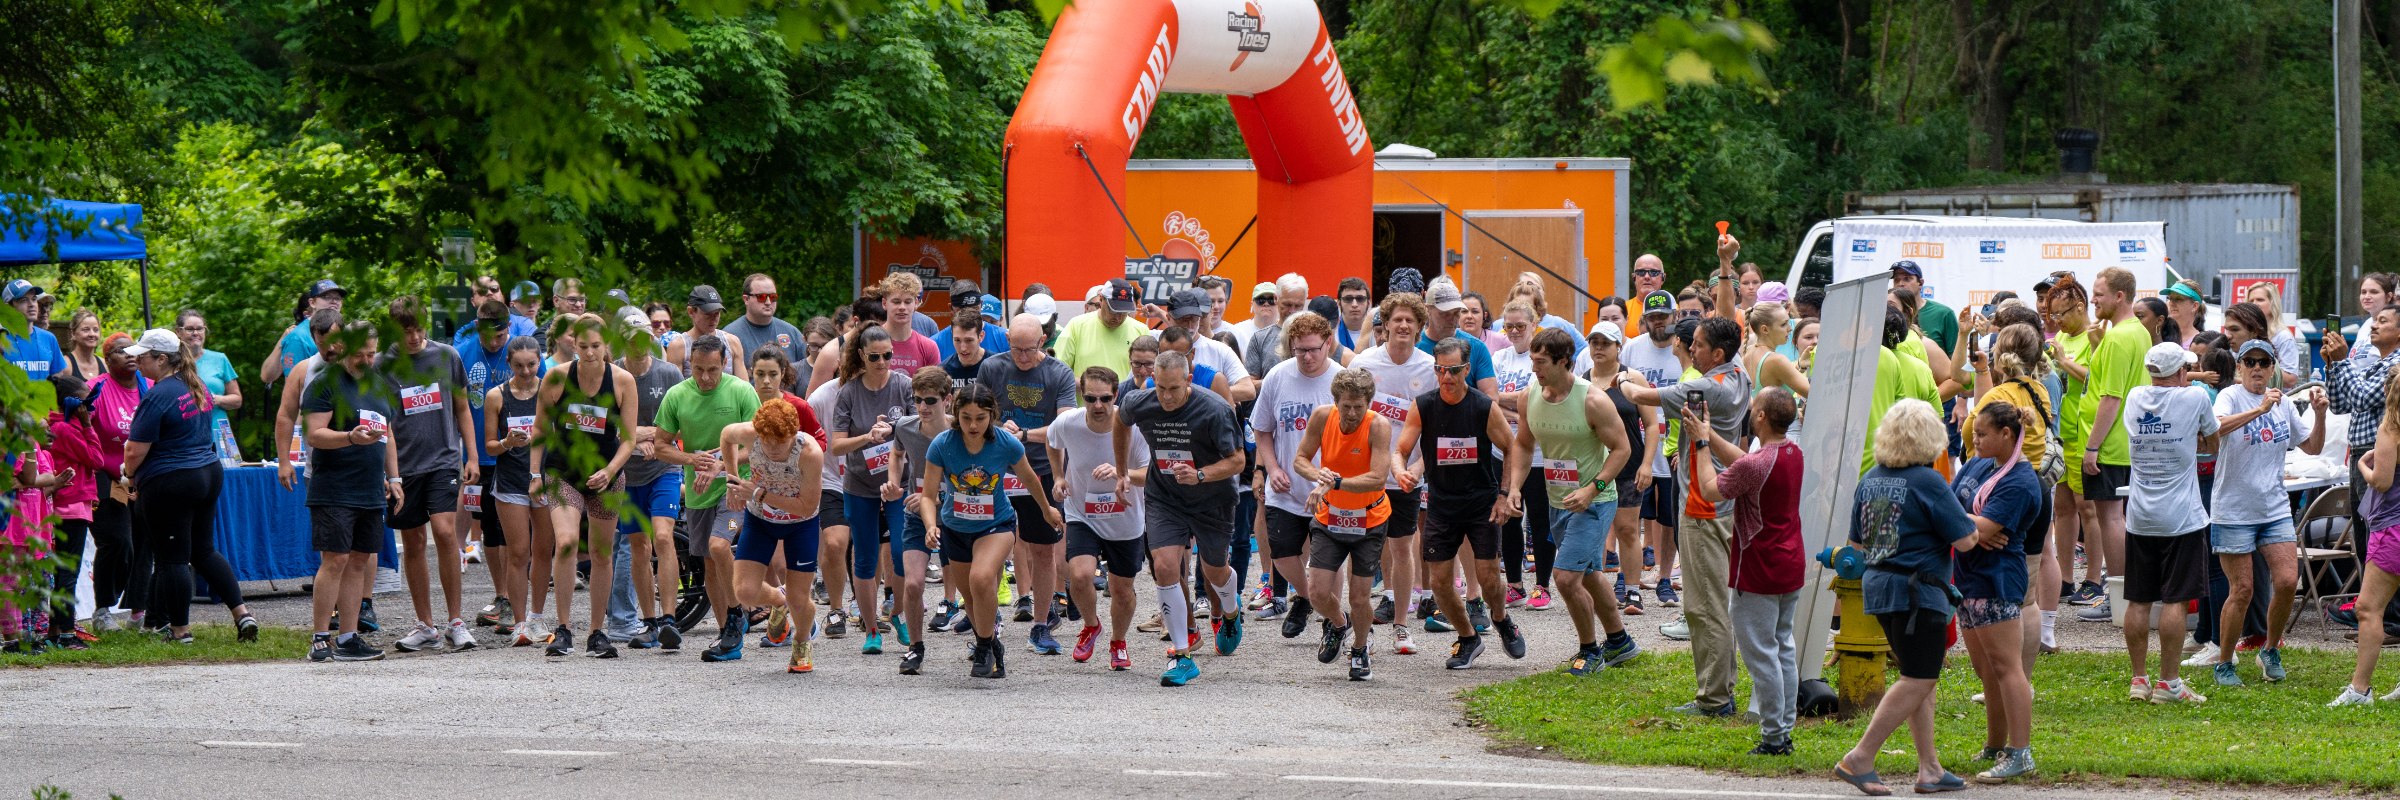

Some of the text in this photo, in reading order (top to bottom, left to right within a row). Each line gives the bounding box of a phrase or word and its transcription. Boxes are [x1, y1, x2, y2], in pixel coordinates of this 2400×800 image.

[1229, 13, 1258, 31] Racing
[1240, 29, 1269, 48] Toes
[1122, 22, 1172, 154] START
[1313, 34, 1368, 156] FINISH
[2043, 245, 2089, 258] LIVE UNITED
[1125, 258, 1194, 279] acing
[922, 278, 953, 288] oes
[1142, 276, 1193, 300] To
[28, 360, 49, 371] UNITED
[411, 394, 433, 407] 300
[1280, 403, 1313, 422] RUN
[1379, 404, 1402, 419] 245
[368, 421, 382, 431] 301
[575, 414, 597, 428] 302
[2138, 422, 2172, 435] INSP
[874, 453, 889, 467] 23
[1446, 448, 1468, 459] 278
[1552, 469, 1570, 481] 221
[961, 503, 985, 514] 258
[1094, 502, 1116, 513] 307
[1336, 516, 1359, 528] 303
